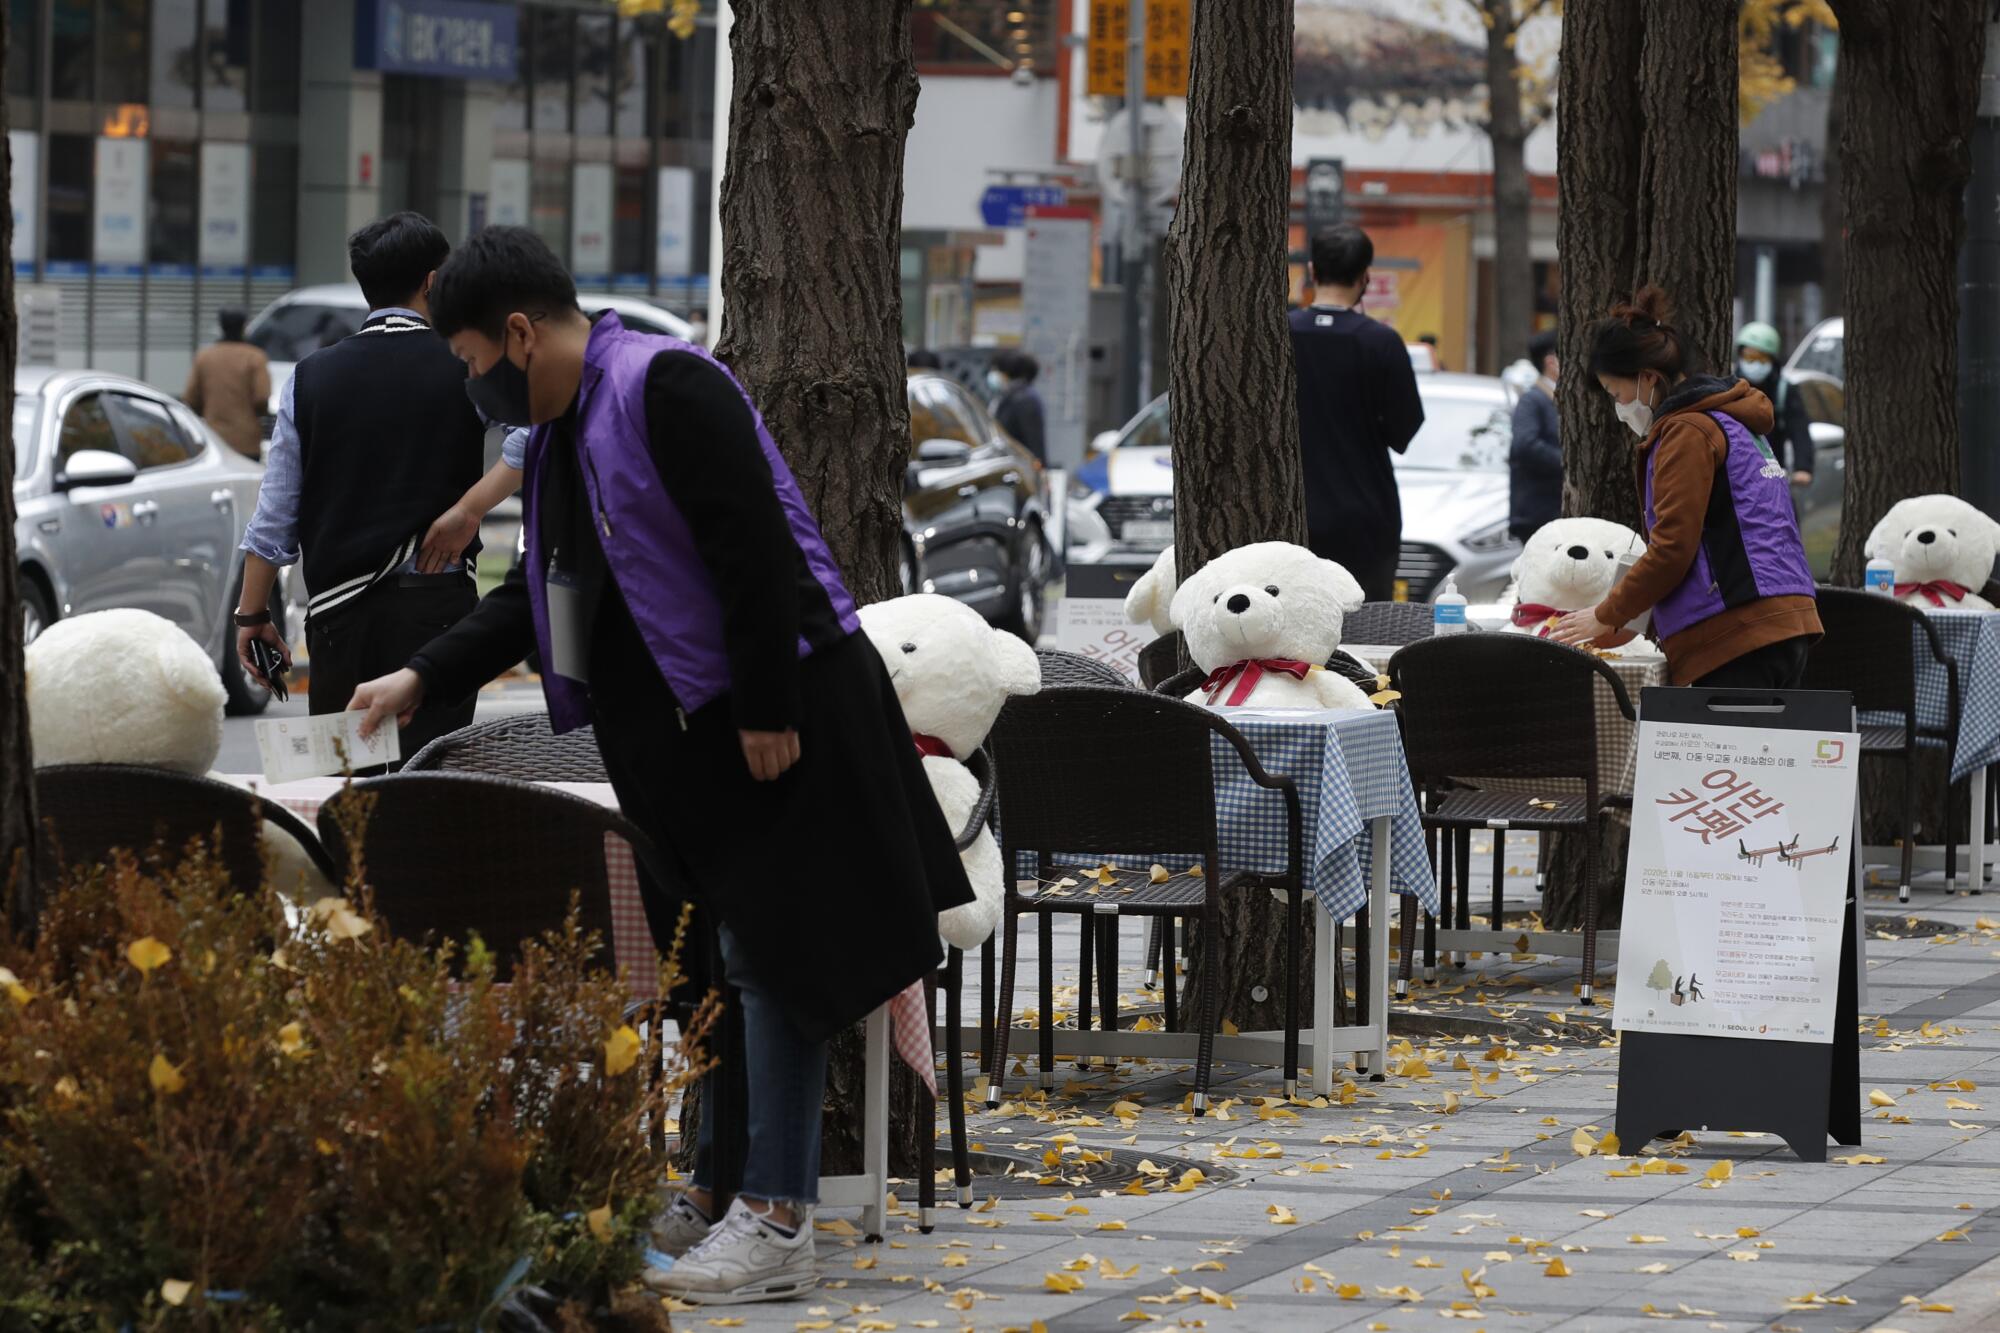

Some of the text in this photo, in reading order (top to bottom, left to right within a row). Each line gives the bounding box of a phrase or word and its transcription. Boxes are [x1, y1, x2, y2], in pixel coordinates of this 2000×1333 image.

[1654, 750, 1682, 761] 네번째,
[1734, 755, 1775, 766] 사회실험의
[1655, 787, 1745, 845] 카펫
[1701, 769, 1785, 824] 어반
